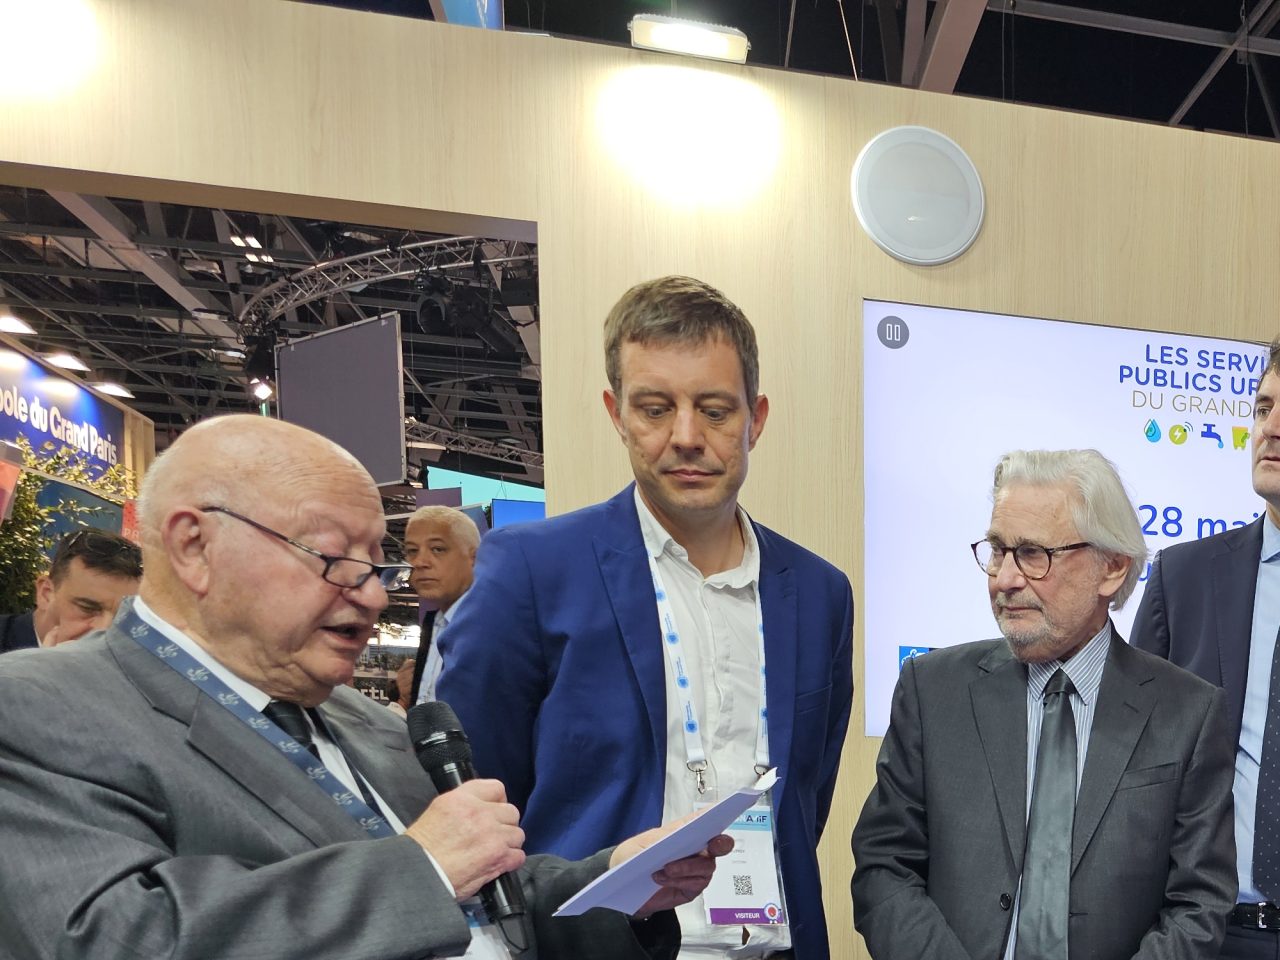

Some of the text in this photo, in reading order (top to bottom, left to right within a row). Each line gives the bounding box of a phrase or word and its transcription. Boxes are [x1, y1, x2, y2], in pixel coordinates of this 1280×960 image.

[1145, 343, 1189, 366] LES
[1119, 365, 1222, 393] PUBLICS
[1132, 390, 1253, 418] DU GRAND
[30, 396, 48, 433] du
[50, 406, 89, 453] Grand
[89, 424, 118, 466] Paris
[1139, 504, 1183, 538] 28
